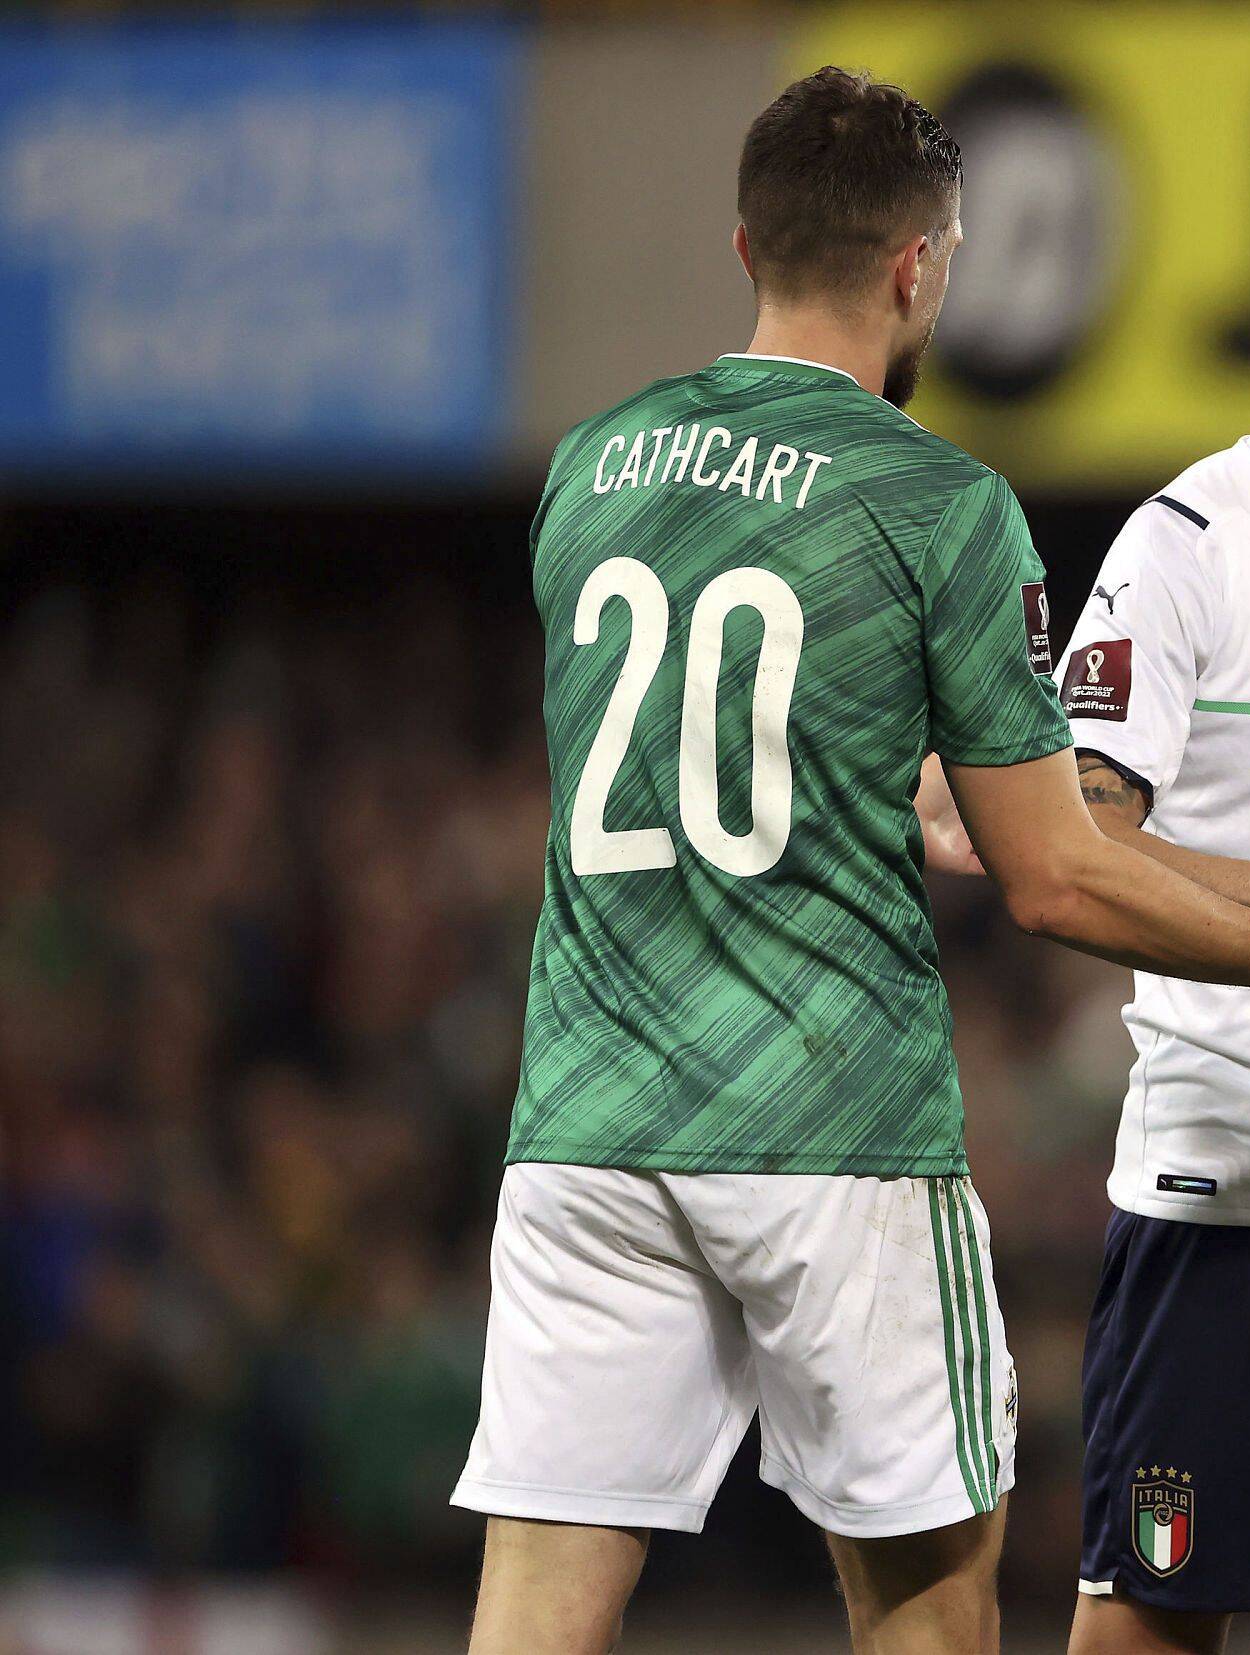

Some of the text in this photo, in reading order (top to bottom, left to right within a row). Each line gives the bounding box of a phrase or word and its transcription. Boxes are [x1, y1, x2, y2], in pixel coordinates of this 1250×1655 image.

[593, 424, 832, 509] CATHCART
[570, 556, 805, 877] 20
[1066, 700, 1115, 711] Qualifiers
[1139, 1489, 1188, 1507] ITALIA
